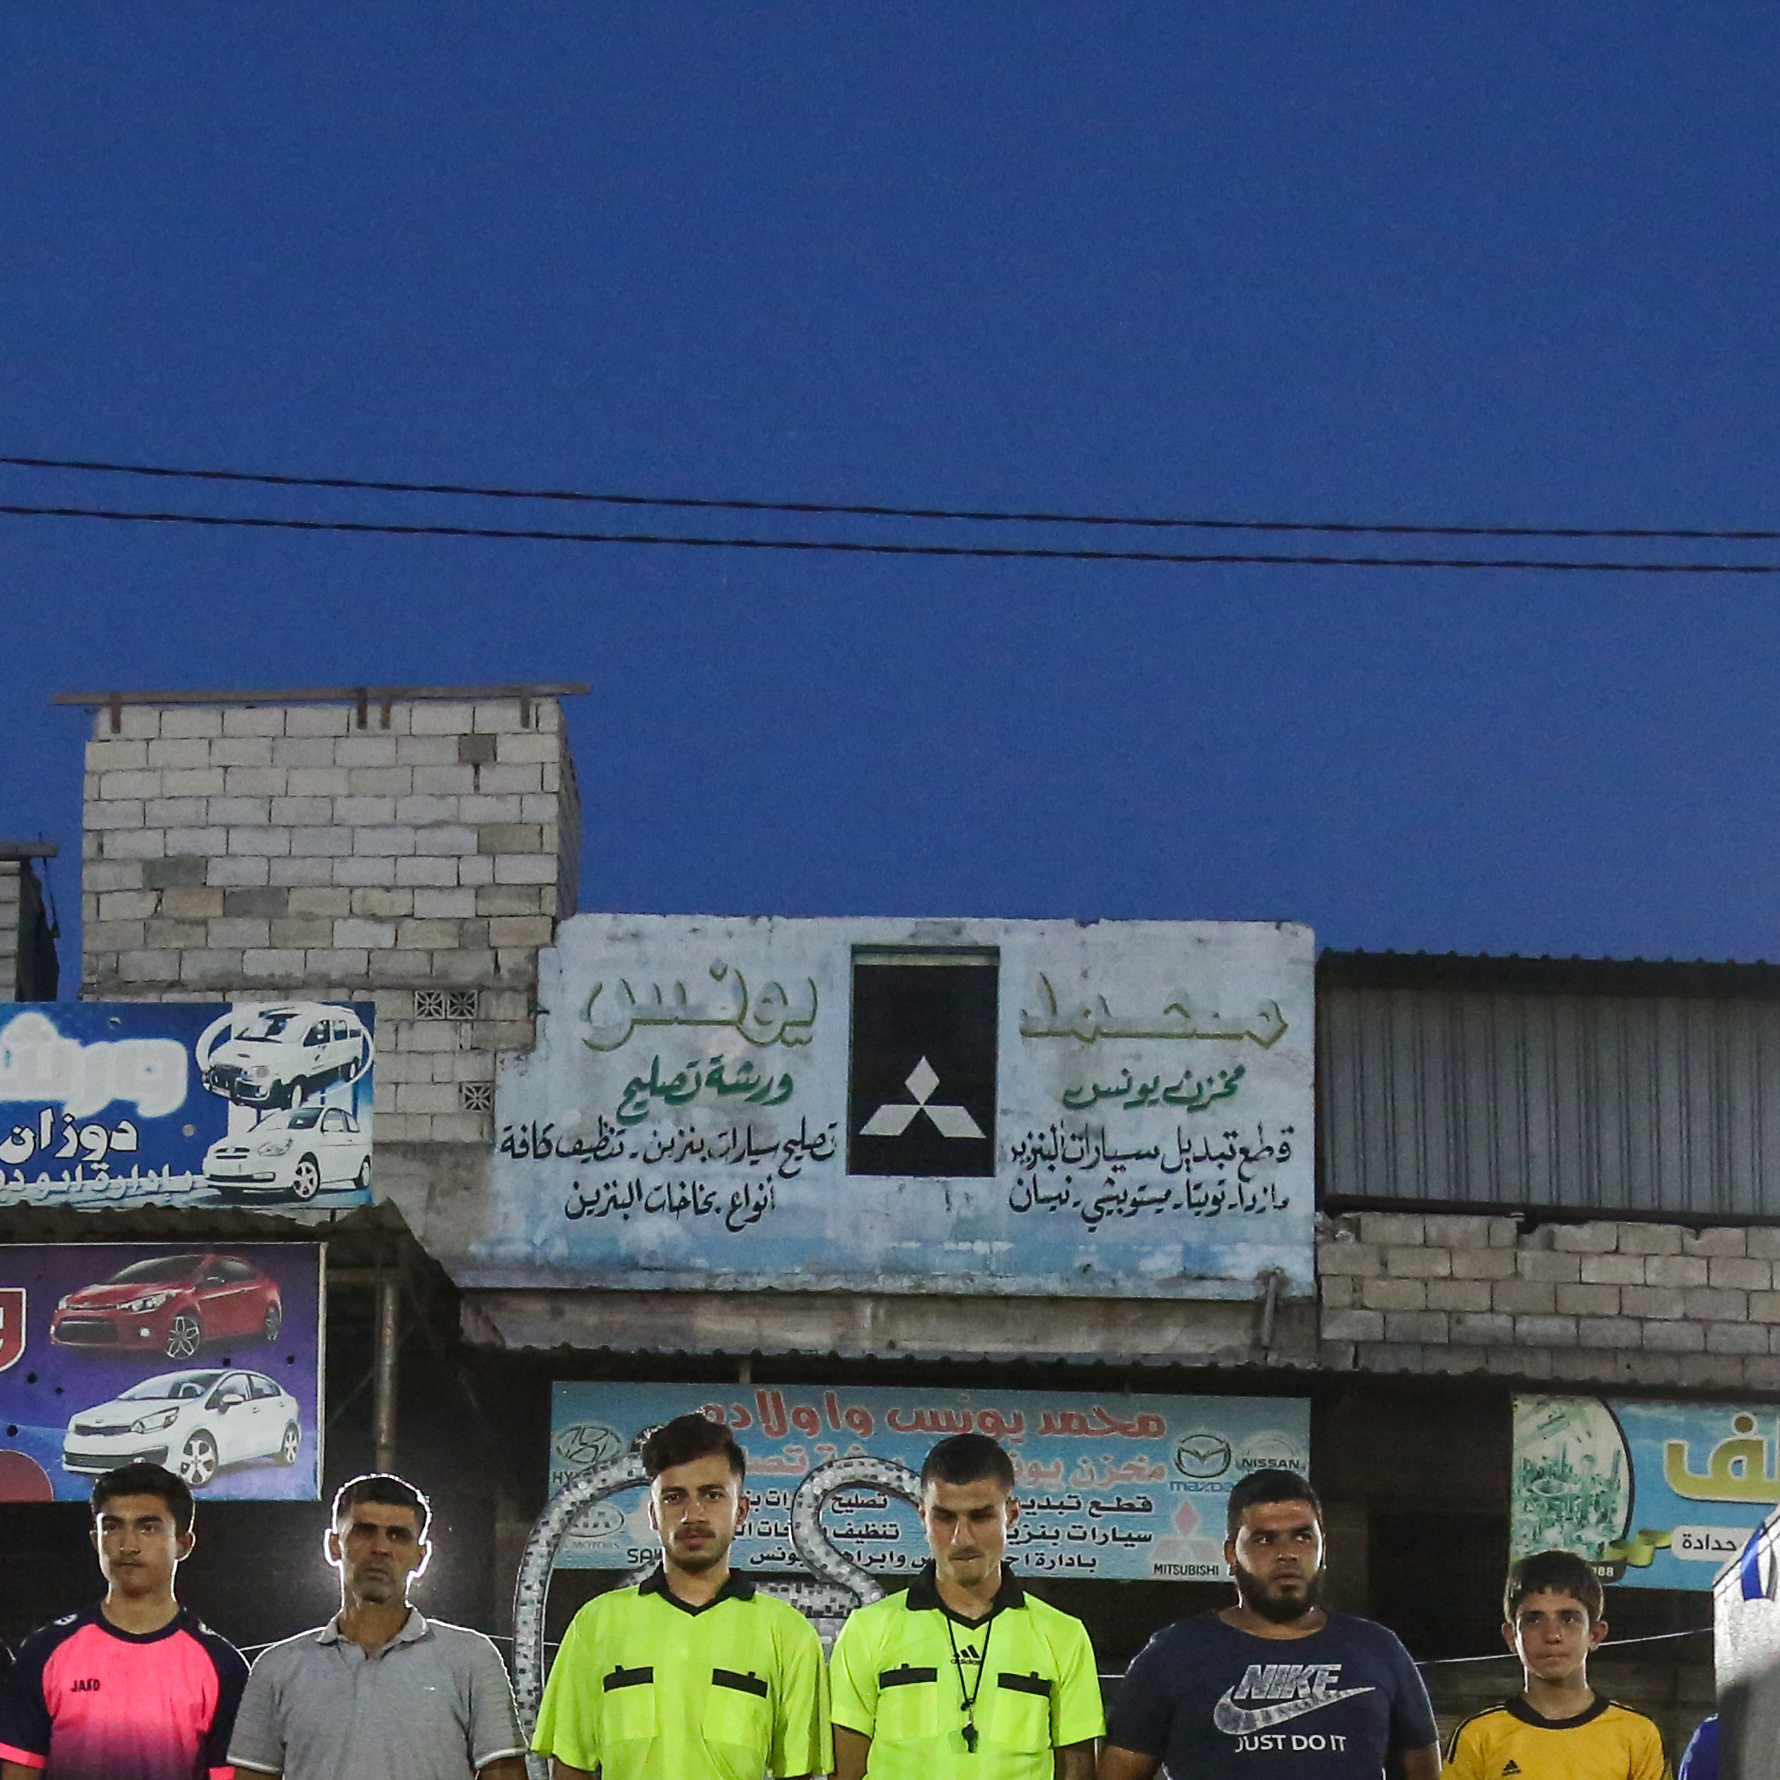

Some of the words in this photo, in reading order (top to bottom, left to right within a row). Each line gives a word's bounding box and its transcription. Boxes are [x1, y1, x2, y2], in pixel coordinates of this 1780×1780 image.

[580, 958, 820, 1051] يونس
[616, 1054, 703, 1126] تصليح
[704, 1053, 795, 1106] ورشة
[1062, 1067, 1160, 1111] يونس
[1162, 1063, 1246, 1113] مخزن
[500, 1119, 555, 1161] كافة
[555, 1114, 628, 1164] تنظيف
[642, 1125, 707, 1165] بنزين
[708, 1123, 780, 1166] سيارات
[778, 1114, 839, 1179] تصليح
[1063, 1123, 1161, 1171] سيارات
[1160, 1125, 1240, 1174] تبديل
[1237, 1120, 1295, 1183] قطع
[564, 1177, 644, 1221] البنزين
[644, 1180, 723, 1219] بخاخات
[725, 1173, 776, 1233] أنواع
[1008, 1173, 1072, 1213] نيسان
[886, 1393, 1025, 1444] يونس
[1038, 1405, 1167, 1439] محمد
[1069, 1453, 1167, 1489] مخزن
[1242, 1458, 1300, 1470] NISSAN
[831, 1492, 889, 1515] تصليح
[1020, 1493, 1083, 1516] تبدي
[1088, 1494, 1154, 1519] قطع
[832, 1521, 902, 1545] تنظيف
[1006, 1525, 1061, 1545] بنزي
[1066, 1527, 1154, 1548] سيارات
[1681, 1531, 1738, 1552] حدادة
[1035, 1550, 1098, 1573] بادارة
[1153, 1563, 1219, 1576] MITSUBISHI
[70, 1679, 100, 1693] JAKO
[1233, 1663, 1343, 1701] NIKE
[1234, 1734, 1287, 1753] JUST
[1291, 1734, 1327, 1751] DO
[1330, 1734, 1347, 1752] IT
